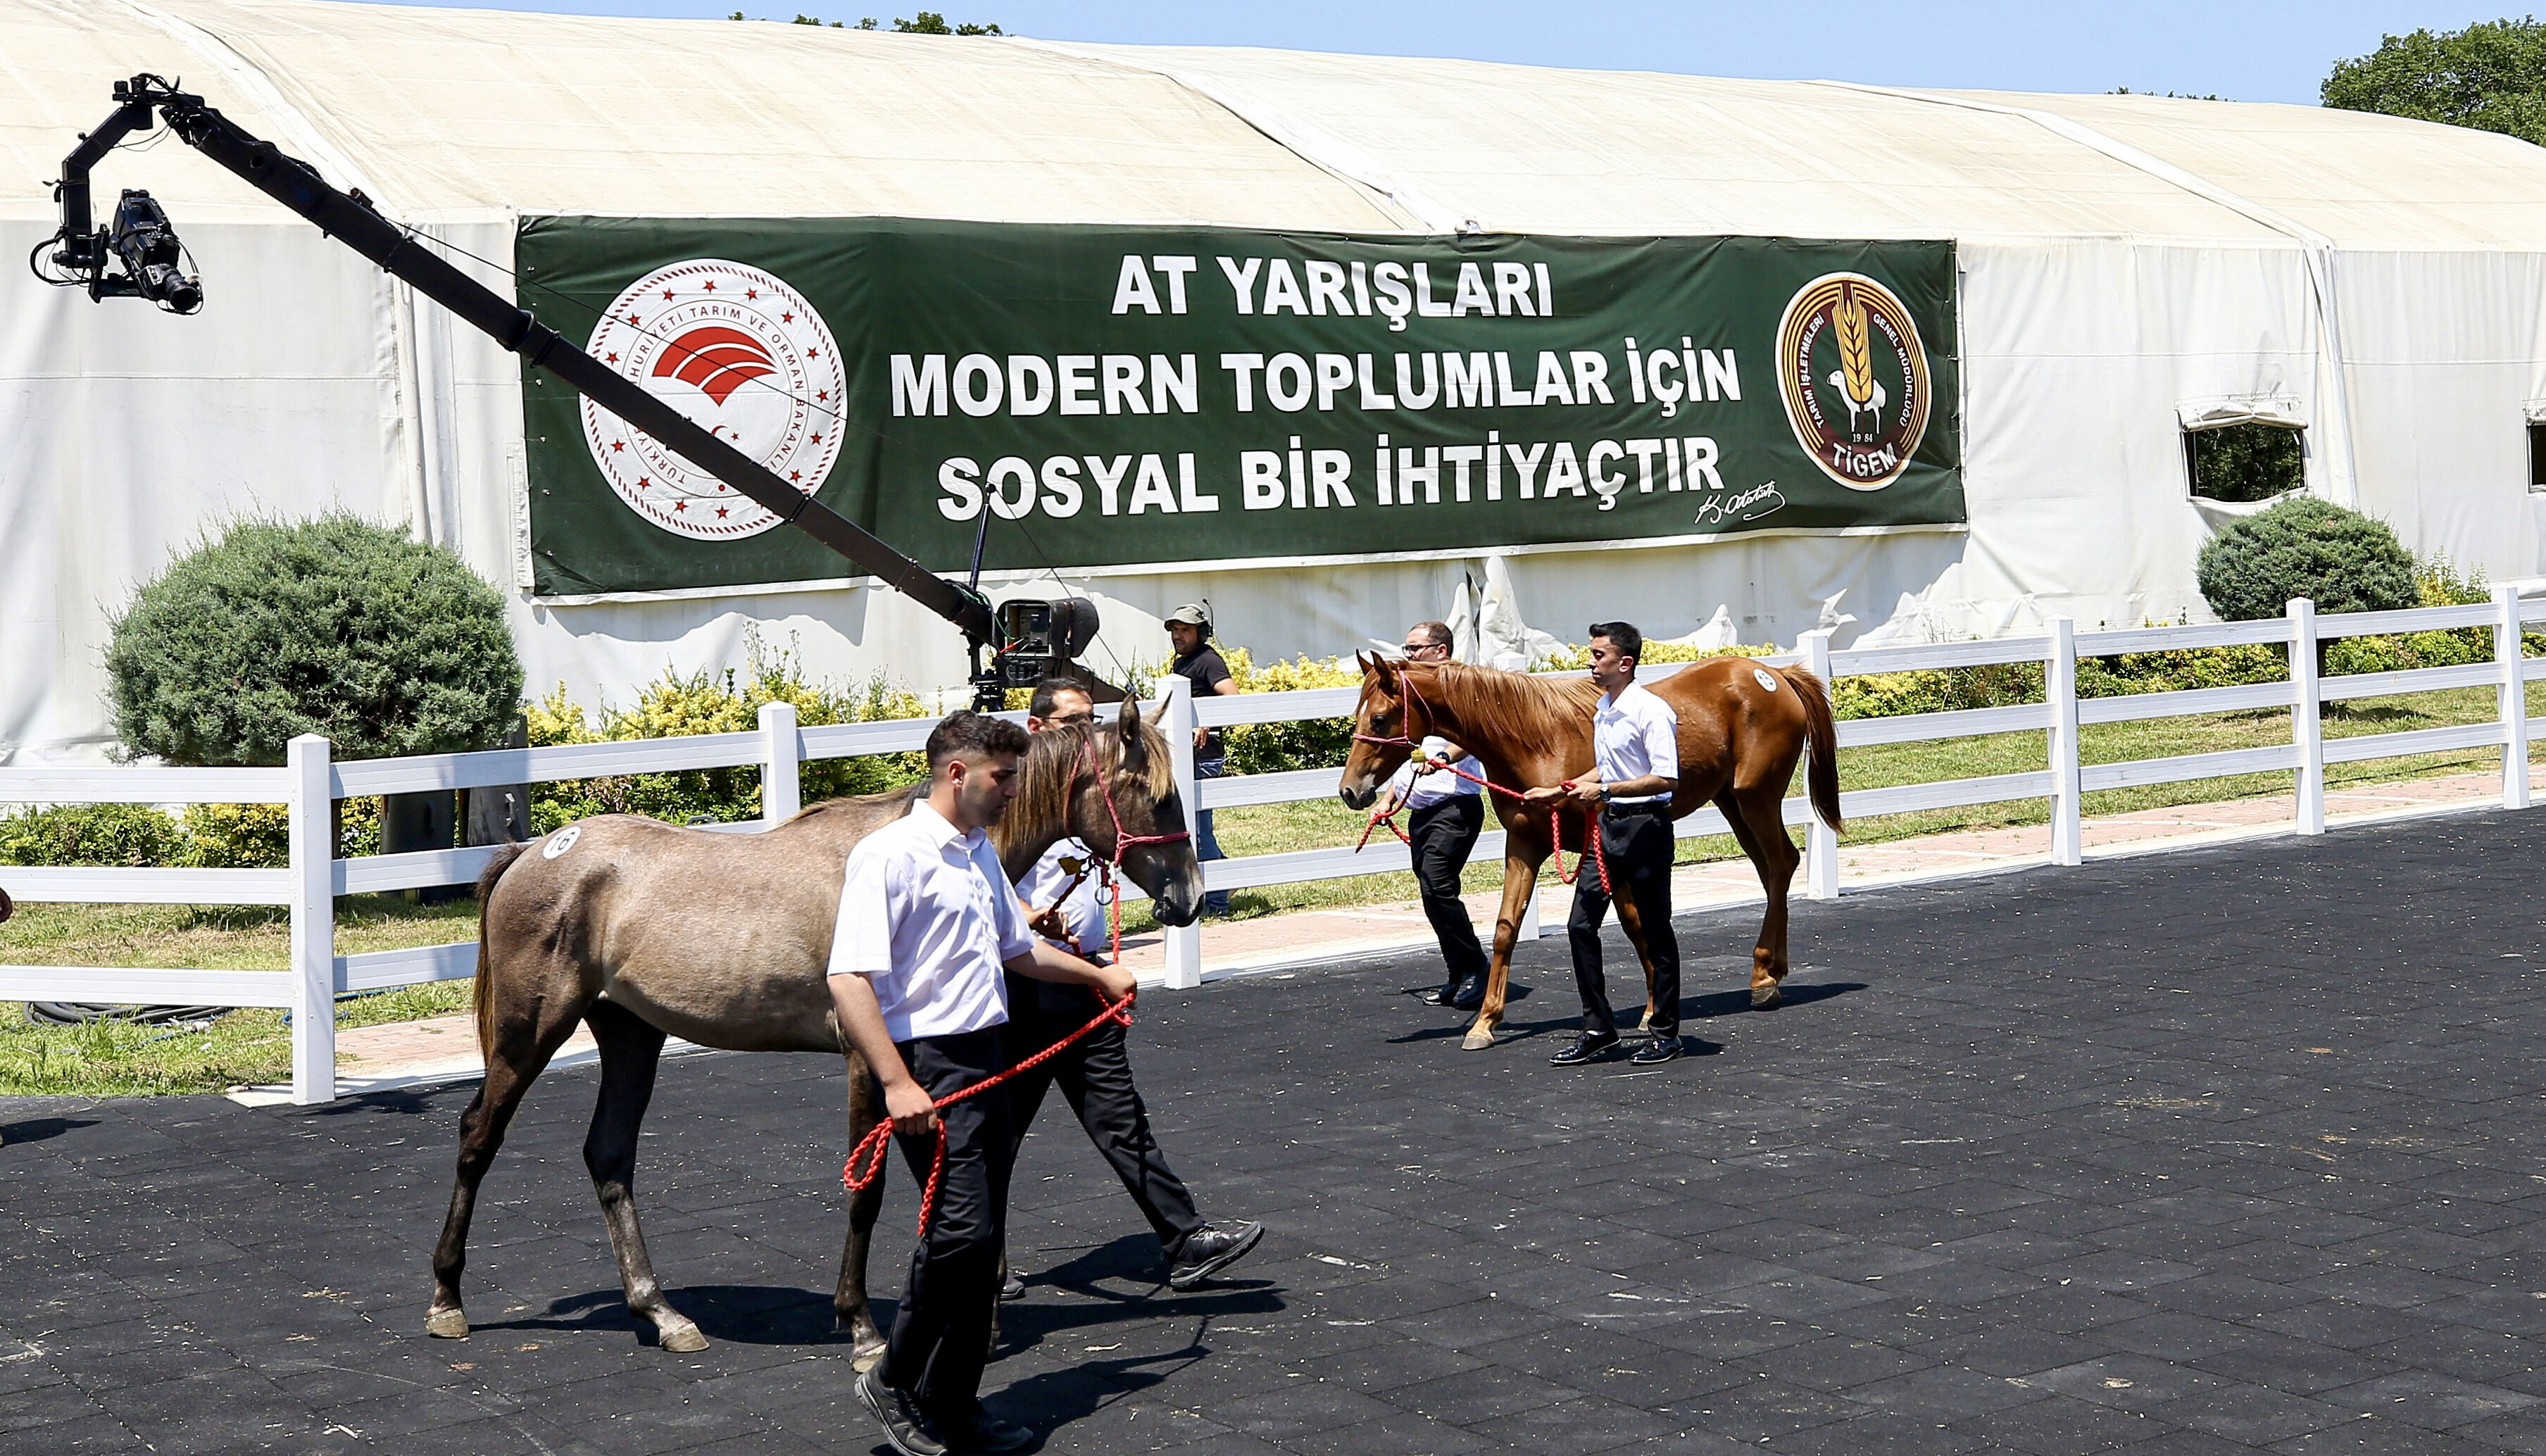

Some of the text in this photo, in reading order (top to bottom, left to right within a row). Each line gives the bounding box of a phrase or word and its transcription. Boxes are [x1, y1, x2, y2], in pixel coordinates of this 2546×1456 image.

[689, 306, 741, 320] TARIM
[1111, 255, 1553, 332] AT YARIŞLARI
[749, 315, 768, 332] VE
[772, 333, 805, 390] ORMAN
[890, 336, 1741, 418] MODERN TOPLUMLAR İÇİN
[1873, 313, 1914, 427] GENEL MÜDÜRLÜĞÜ
[764, 398, 805, 471] BAKANLI
[1804, 389, 1825, 429] TARIM
[937, 430, 1725, 521] SOSYAL BİR İHTİYAÇTIR
[1833, 441, 1898, 477] TİGEM
[549, 831, 576, 852] 16
